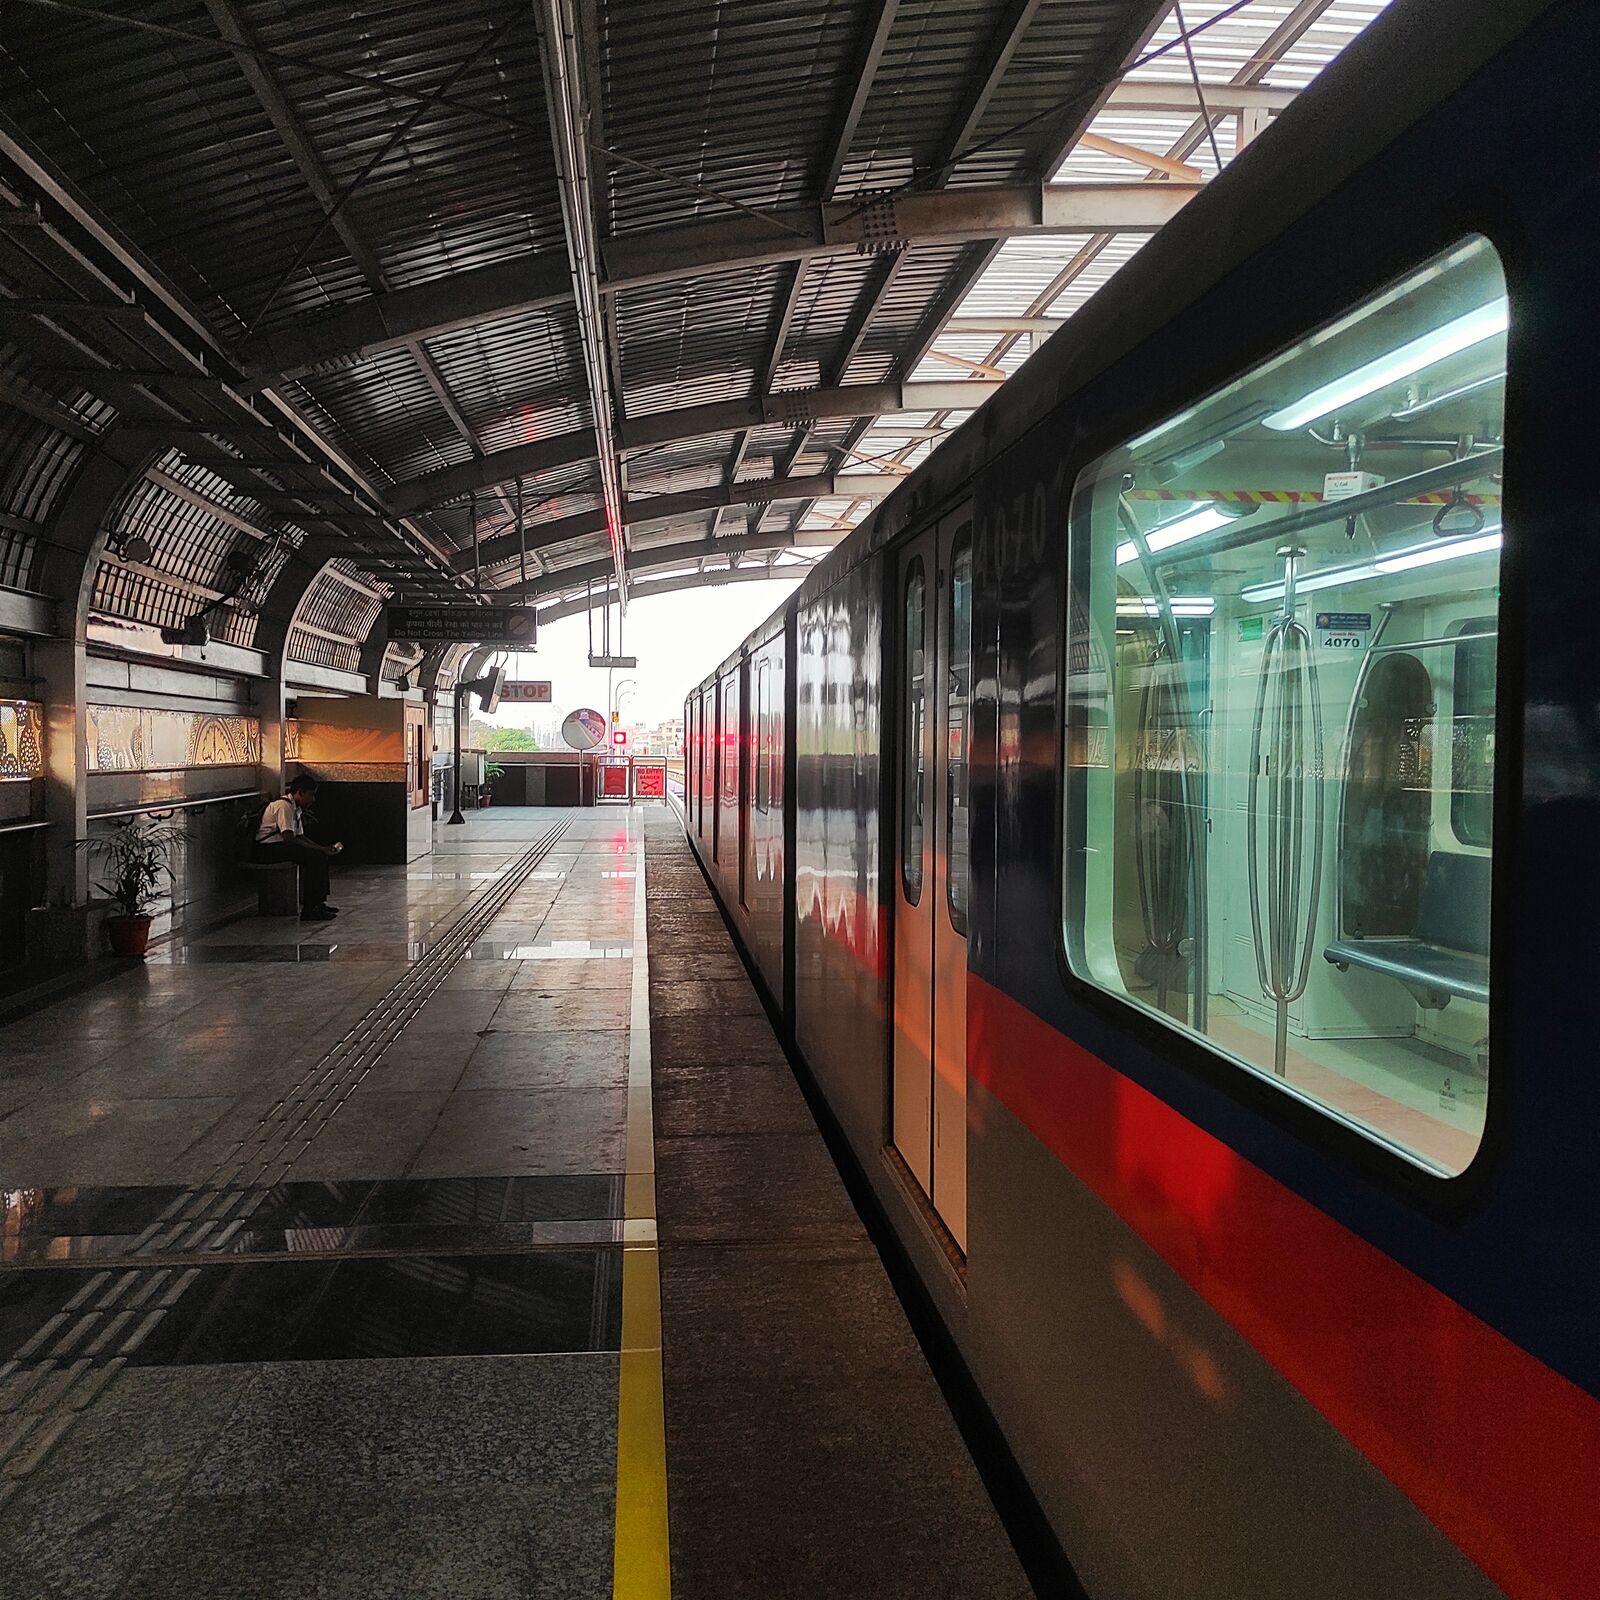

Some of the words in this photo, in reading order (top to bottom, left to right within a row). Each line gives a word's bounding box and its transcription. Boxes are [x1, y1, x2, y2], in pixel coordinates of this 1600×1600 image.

[394, 629, 406, 637] Do
[407, 629, 421, 637] Not
[423, 629, 443, 638] Cross
[446, 629, 460, 638] The
[1324, 638, 1359, 647] 4070
[501, 685, 548, 697] STOP
